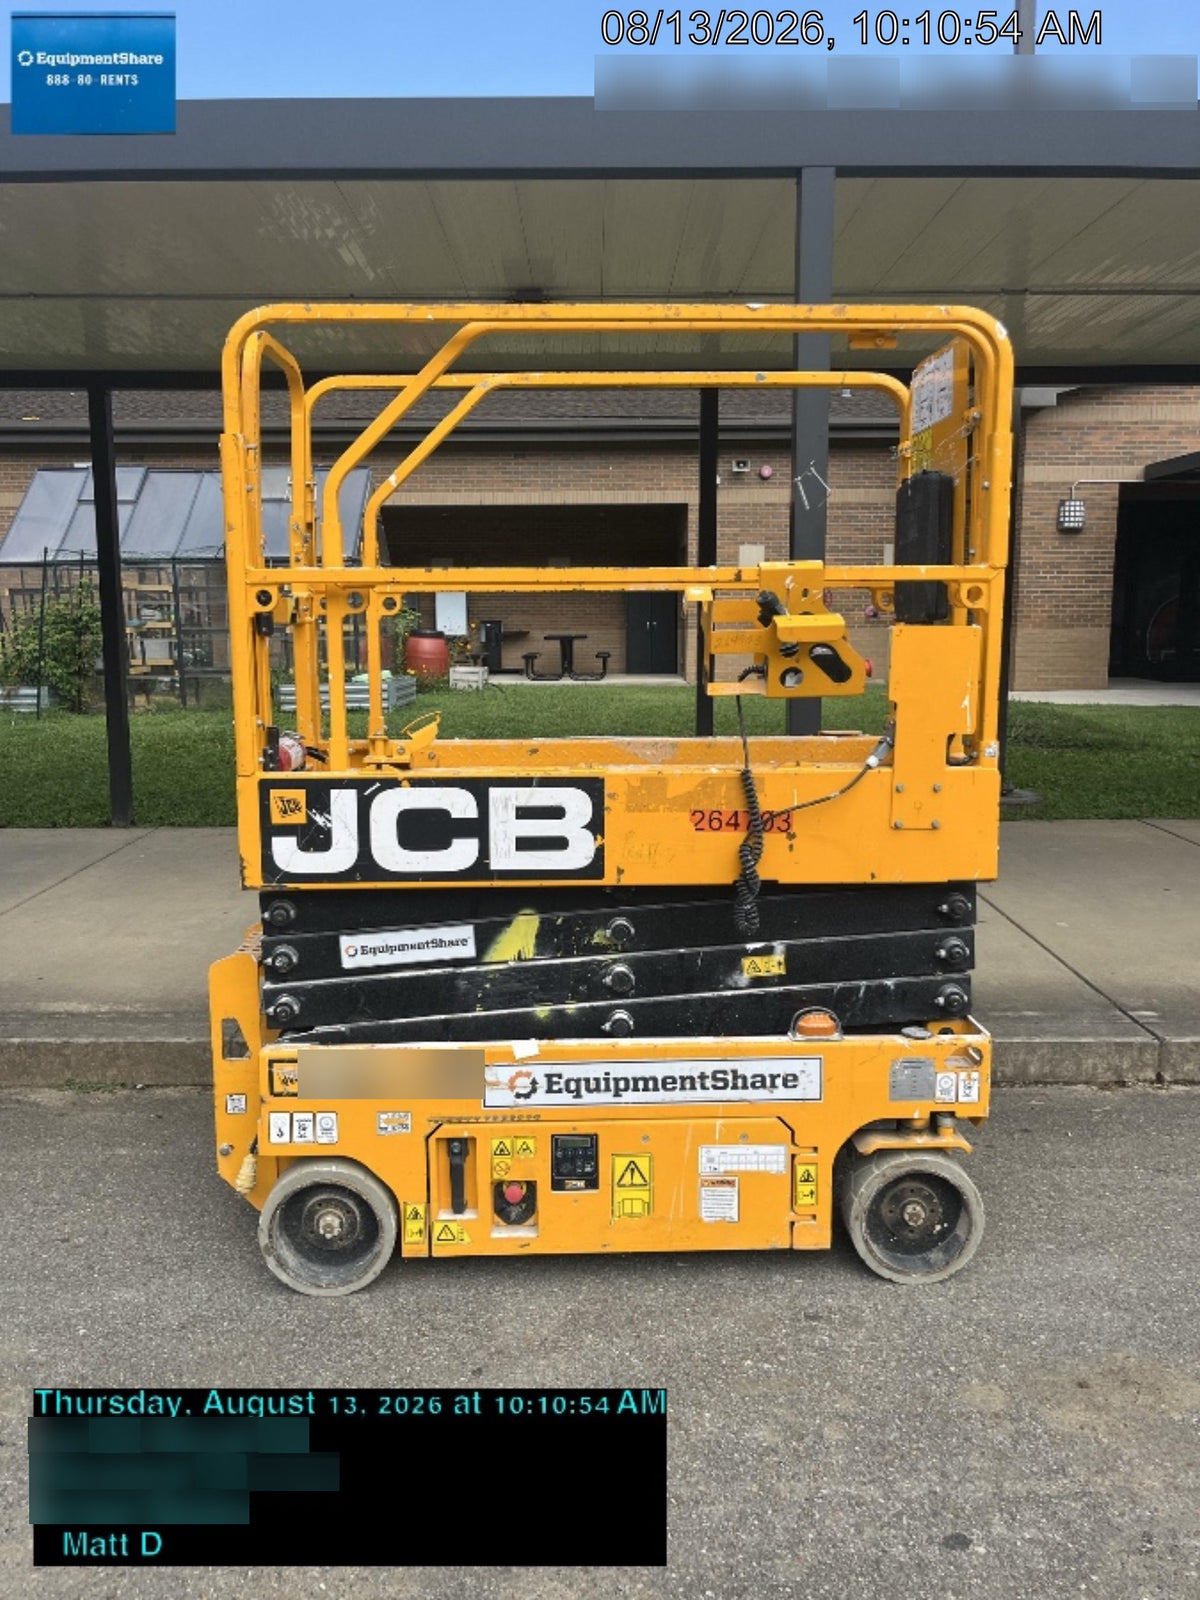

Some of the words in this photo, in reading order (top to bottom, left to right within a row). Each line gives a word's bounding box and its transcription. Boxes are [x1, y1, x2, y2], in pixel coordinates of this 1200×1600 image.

[271, 787, 596, 874] JCB
[360, 938, 468, 956] EquipmentShare
[544, 1069, 800, 1099] EquipmentShare
